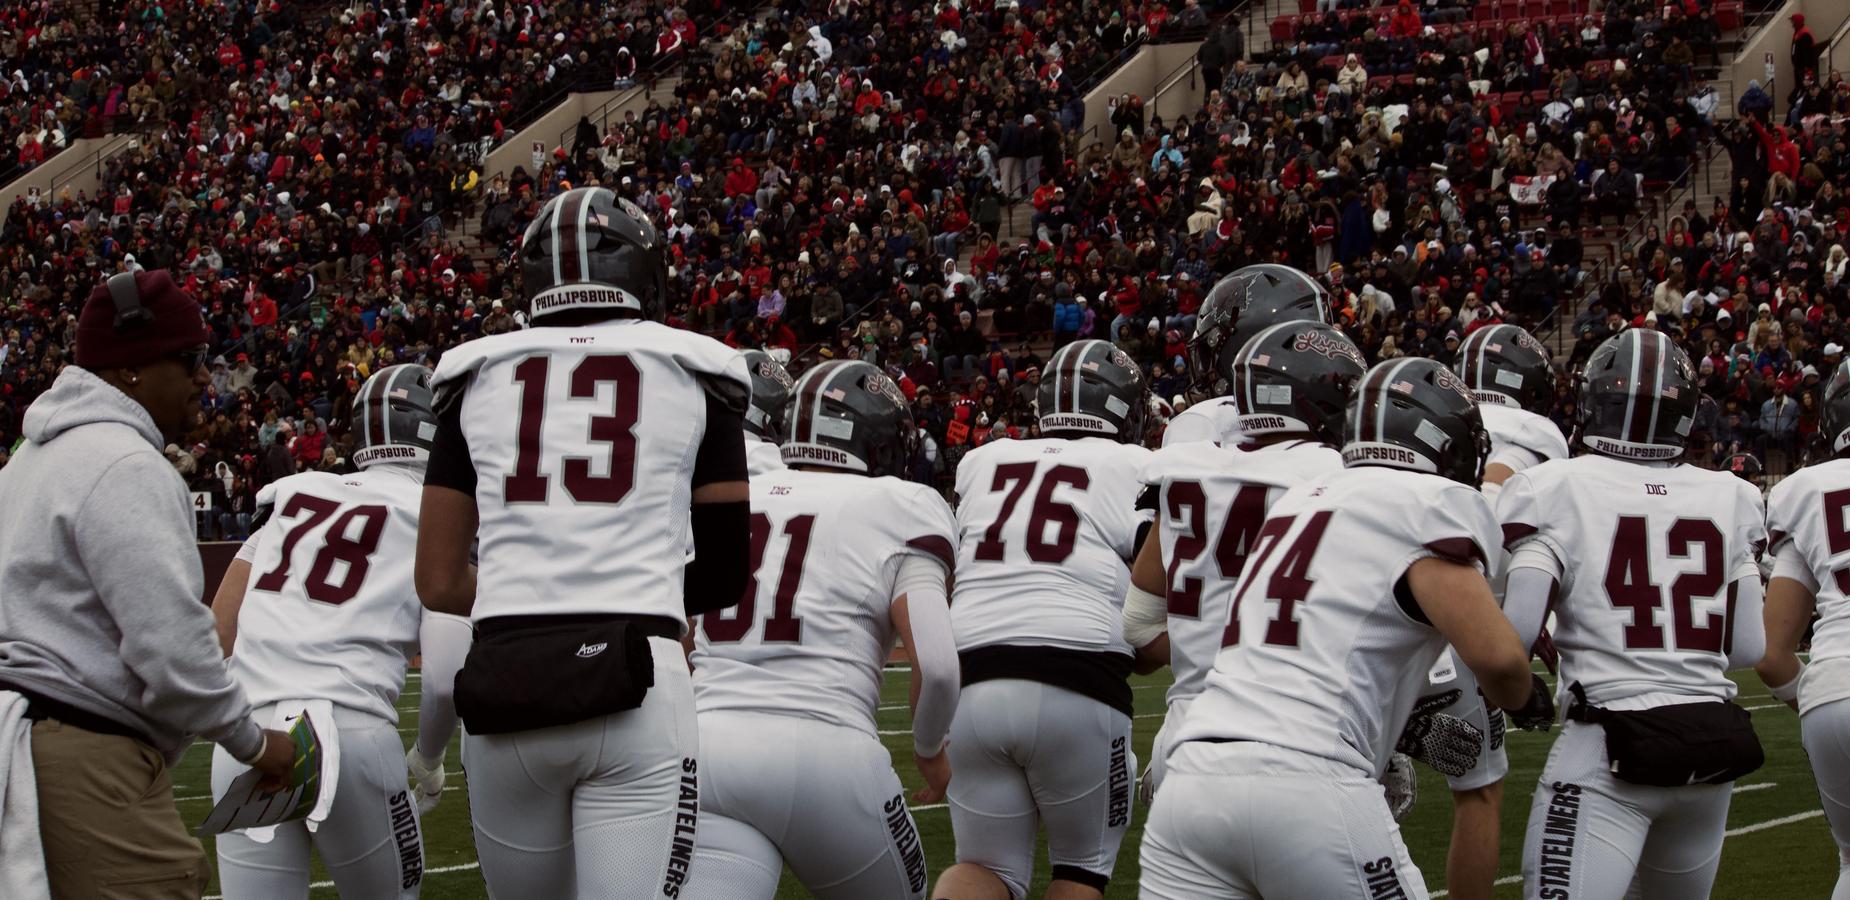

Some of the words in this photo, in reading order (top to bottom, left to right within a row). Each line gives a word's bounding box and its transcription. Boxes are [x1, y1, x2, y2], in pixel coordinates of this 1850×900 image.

[535, 290, 624, 310] PHILLIPSBURG
[503, 353, 643, 506] 13
[1041, 417, 1103, 430] PHILLIPSBURG
[1475, 393, 1505, 404] SBURG
[354, 447, 416, 465] PHILLIPSBURG
[782, 447, 847, 464] HILLIPSBURG
[1596, 440, 1676, 458] PHILLIPSBURG
[1645, 483, 1667, 496] DIG
[195, 493, 206, 509] 4
[252, 491, 391, 608] 78
[972, 461, 1092, 565] 76
[1165, 479, 1272, 621] 24
[1218, 508, 1338, 652] 74
[1601, 513, 1727, 655] 42
[662, 757, 698, 900] STATELINERS
[1108, 735, 1129, 829] STATELINERS
[390, 790, 423, 891] STATELINERS
[884, 794, 928, 894] STATELINERS
[1539, 781, 1583, 900] STATELINERS
